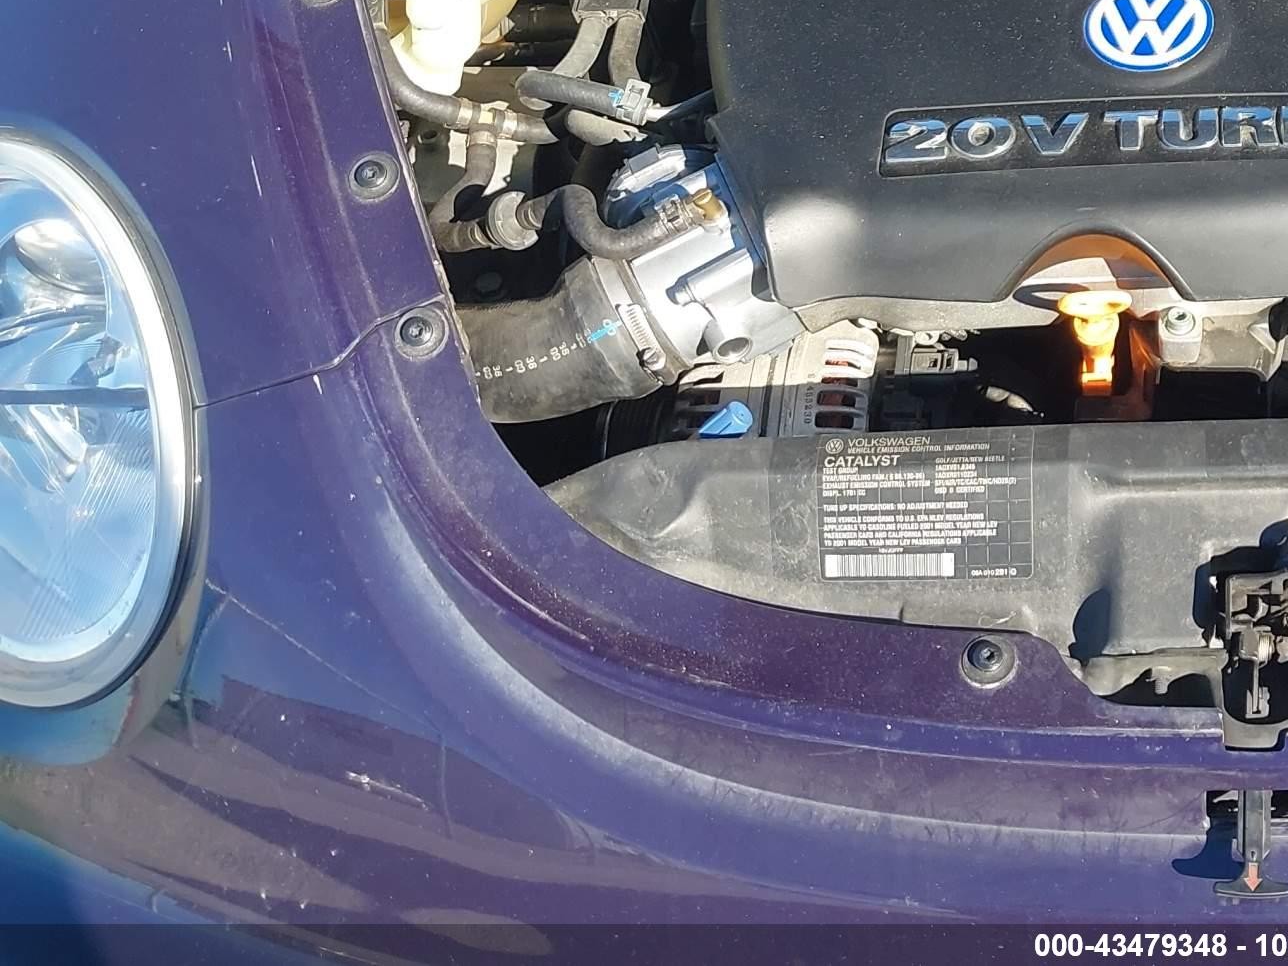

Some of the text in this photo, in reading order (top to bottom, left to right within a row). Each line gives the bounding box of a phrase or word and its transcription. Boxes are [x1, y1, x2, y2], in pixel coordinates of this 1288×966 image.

[884, 111, 1090, 163] 20V
[848, 437, 931, 448] VOLKSWAGEN
[944, 443, 990, 451] INFORMATION
[824, 455, 900, 467] CATALYST
[880, 480, 906, 488] CONTROL
